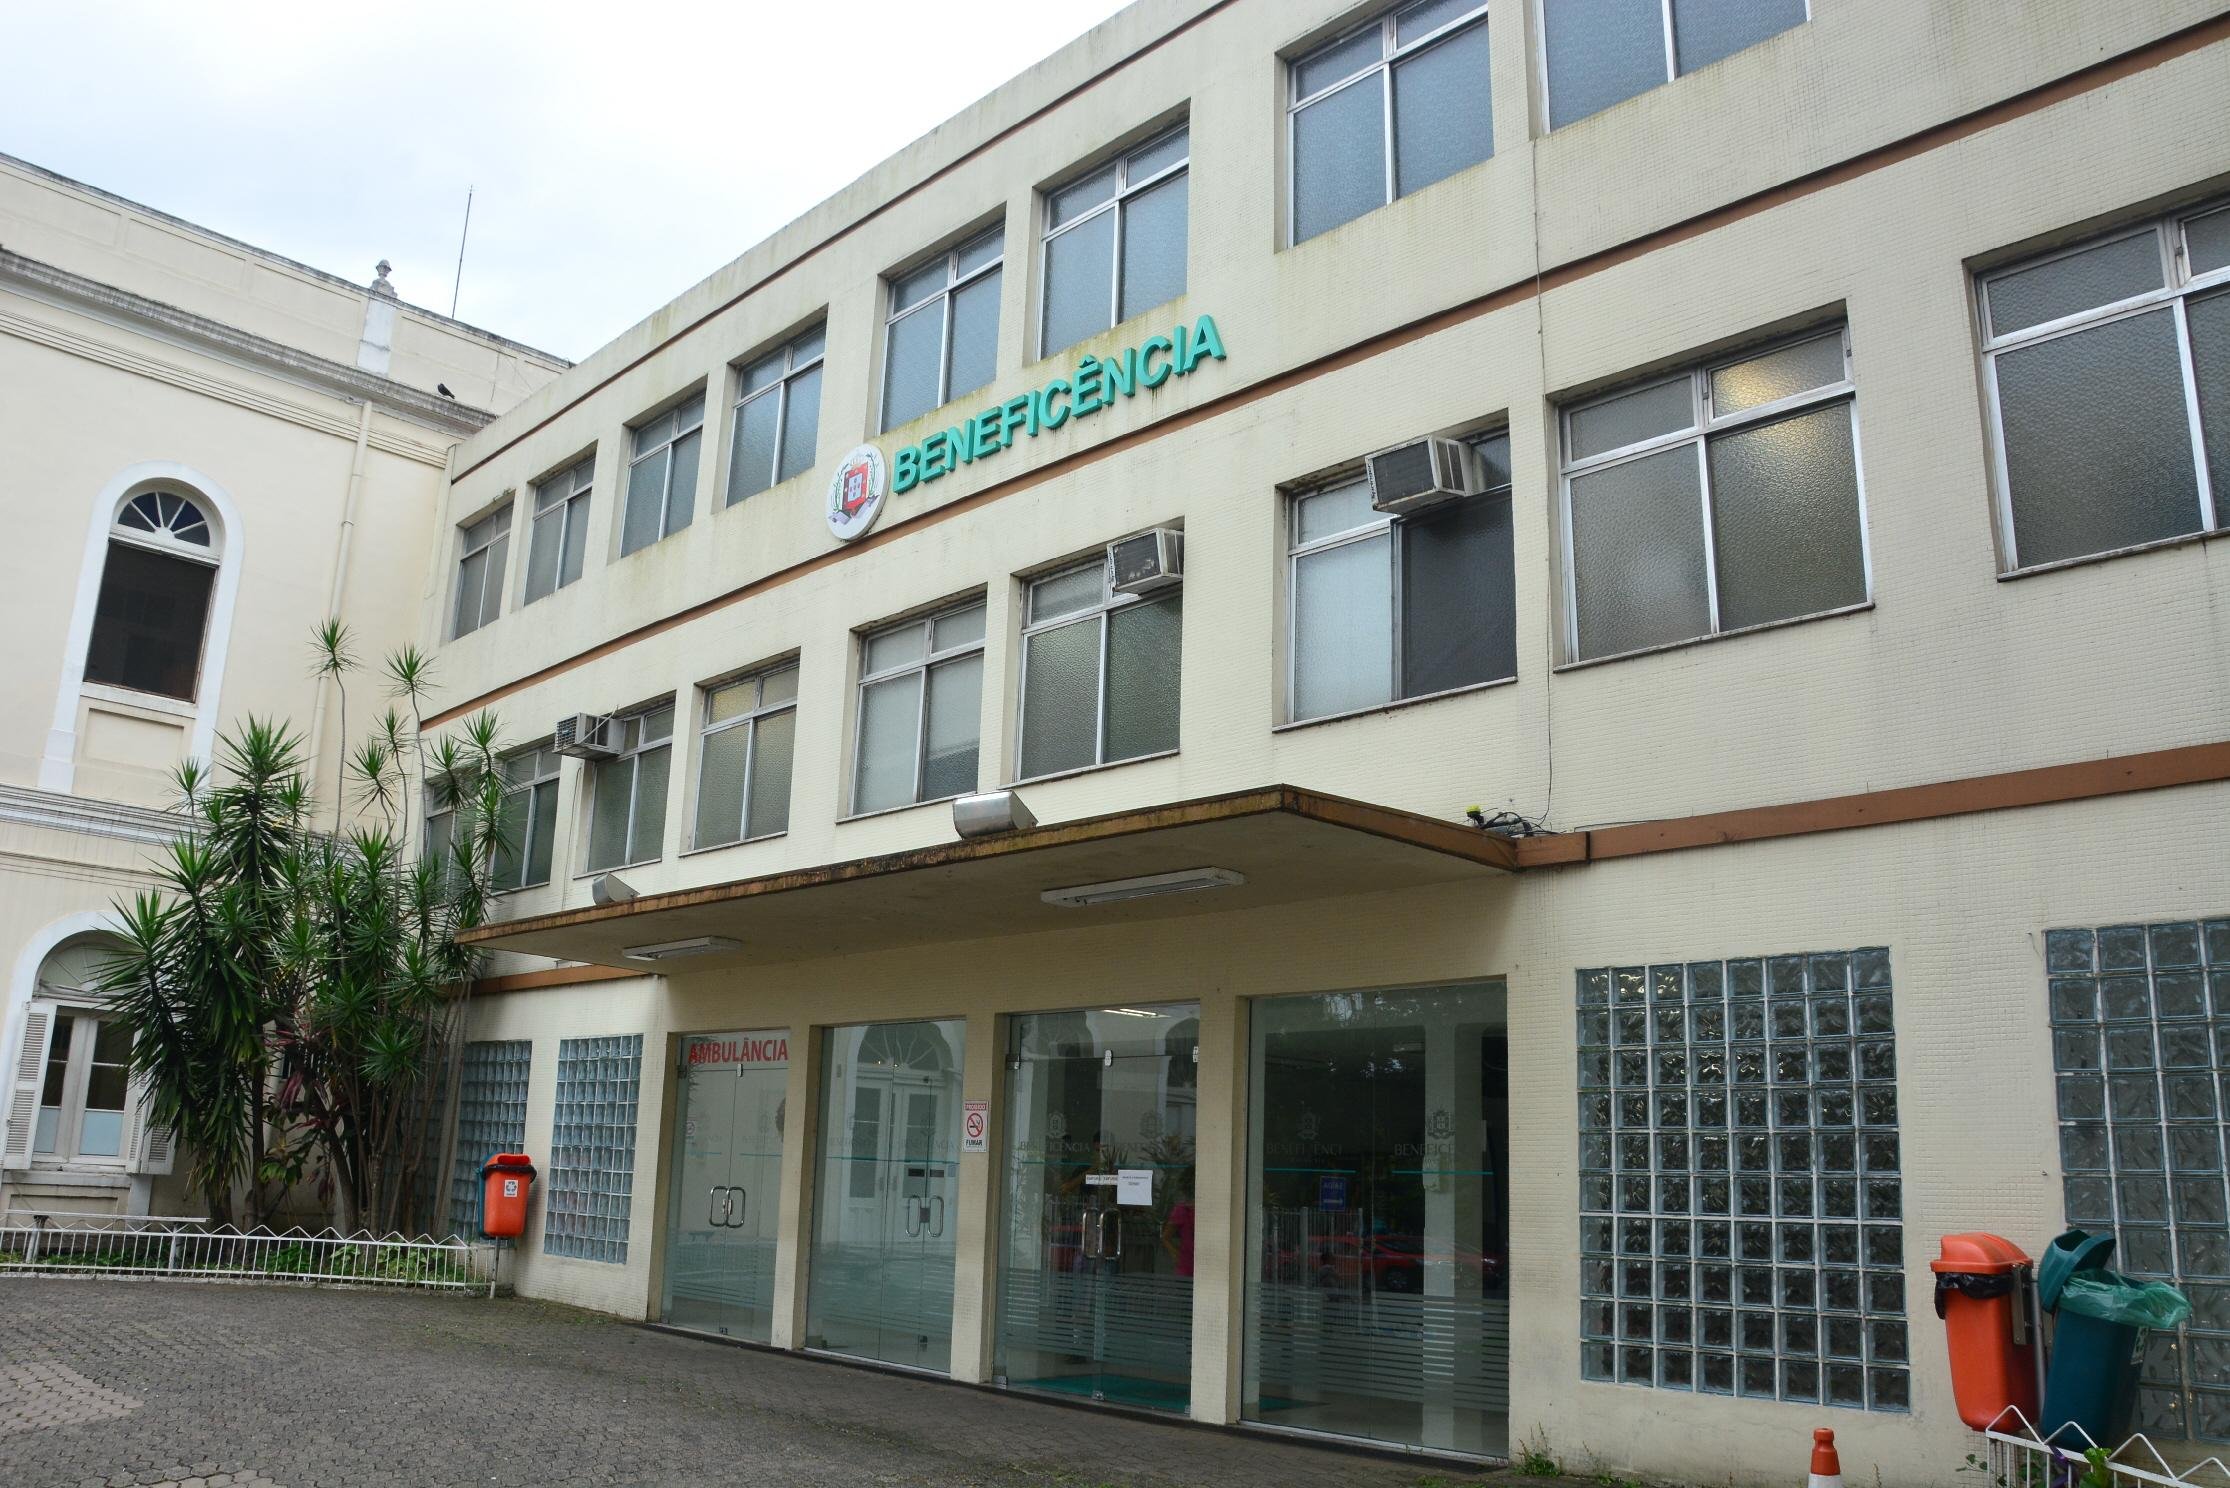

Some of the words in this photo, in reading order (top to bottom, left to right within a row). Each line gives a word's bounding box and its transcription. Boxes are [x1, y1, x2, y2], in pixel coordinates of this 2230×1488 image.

[892, 314, 1227, 494] BENEFICÊNCIA
[688, 1037, 788, 1063] AMBULÂNCIA
[965, 1139, 983, 1147] FUMAR
